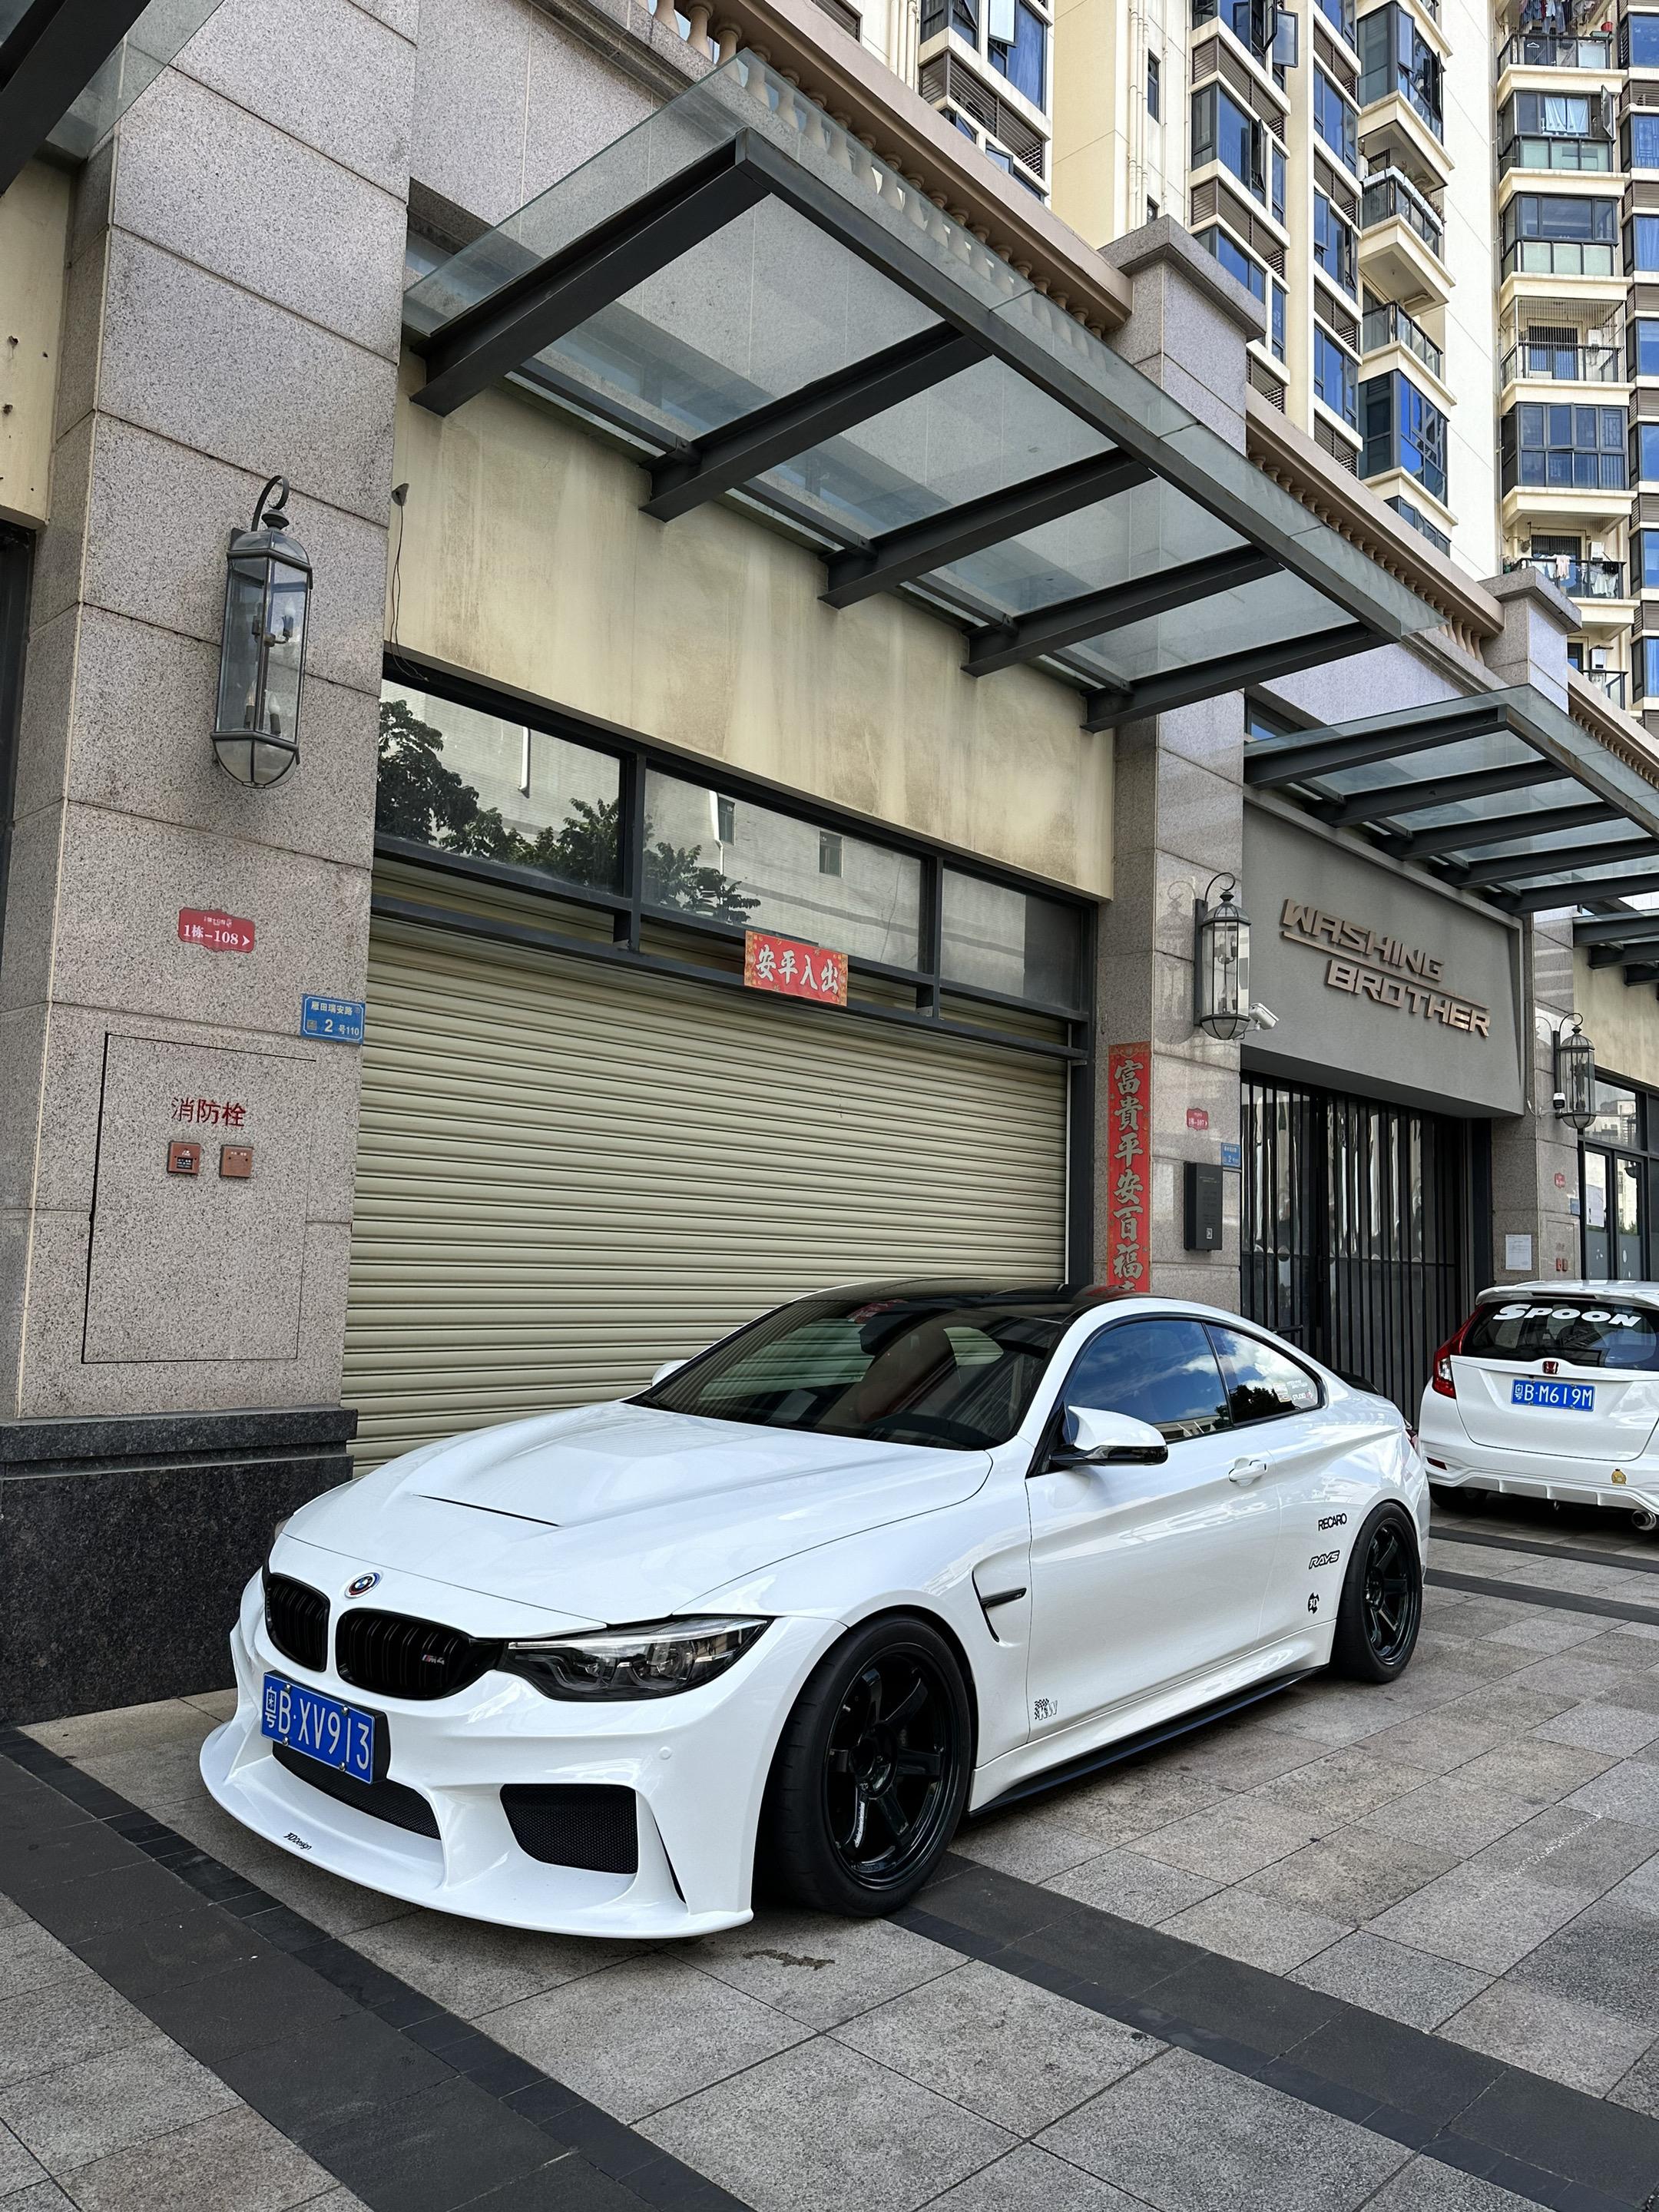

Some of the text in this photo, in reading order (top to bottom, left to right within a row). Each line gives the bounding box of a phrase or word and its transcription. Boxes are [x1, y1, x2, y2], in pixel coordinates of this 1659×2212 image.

[1281, 898, 1444, 982] WASHING
[1326, 959, 1491, 1038] BROTHER
[324, 1018, 333, 1032] 2
[171, 1097, 247, 1127] 消防栓
[1318, 1513, 1347, 1531] RECARO
[1309, 1550, 1340, 1569] RAYS
